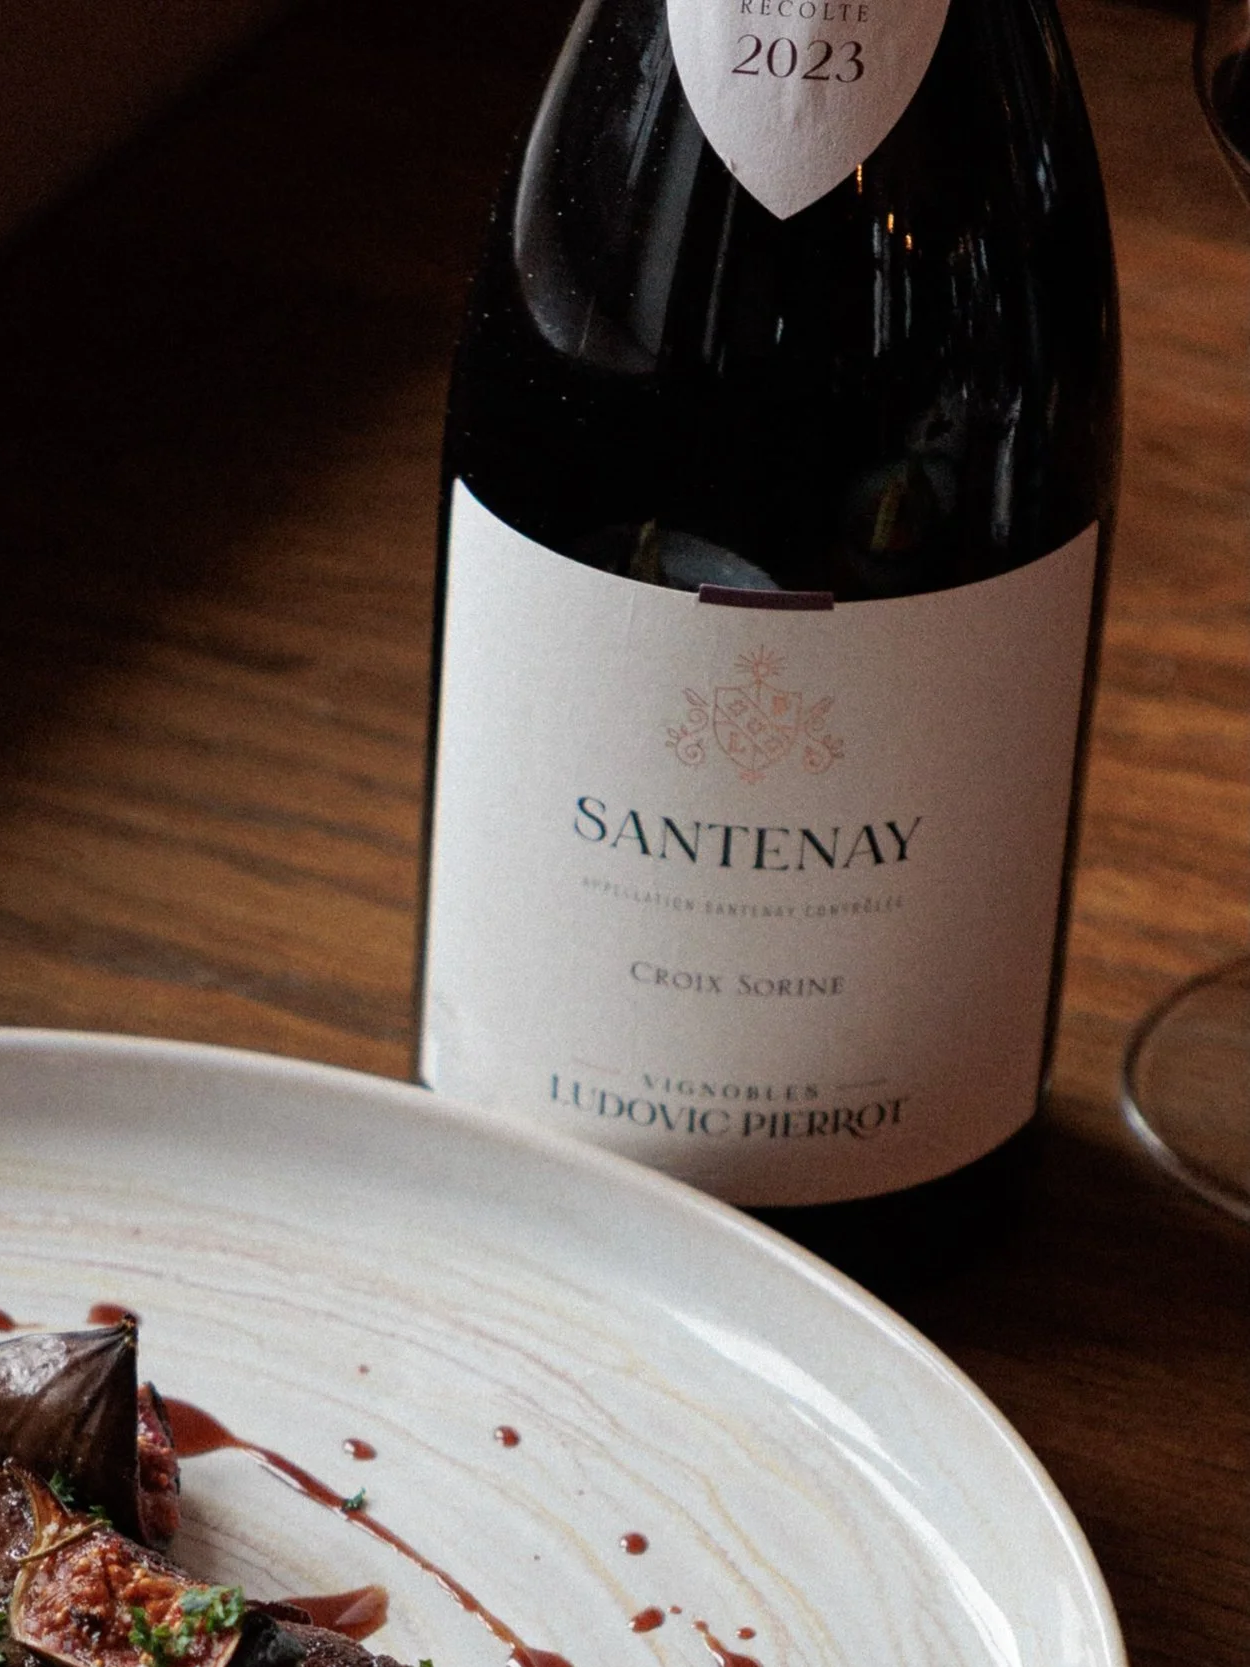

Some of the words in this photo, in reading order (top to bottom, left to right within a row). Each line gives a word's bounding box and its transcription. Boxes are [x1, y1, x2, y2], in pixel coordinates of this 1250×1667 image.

[731, 34, 865, 83] 2023
[573, 796, 923, 871] SANTENAY
[704, 899, 795, 918] SANTENAY
[630, 960, 723, 994] CROIX
[736, 973, 846, 997] SORINE
[550, 1074, 732, 1138] LUDOVIC
[741, 1096, 911, 1140] PIERROT
[642, 1073, 819, 1102] VIGNOBLES
